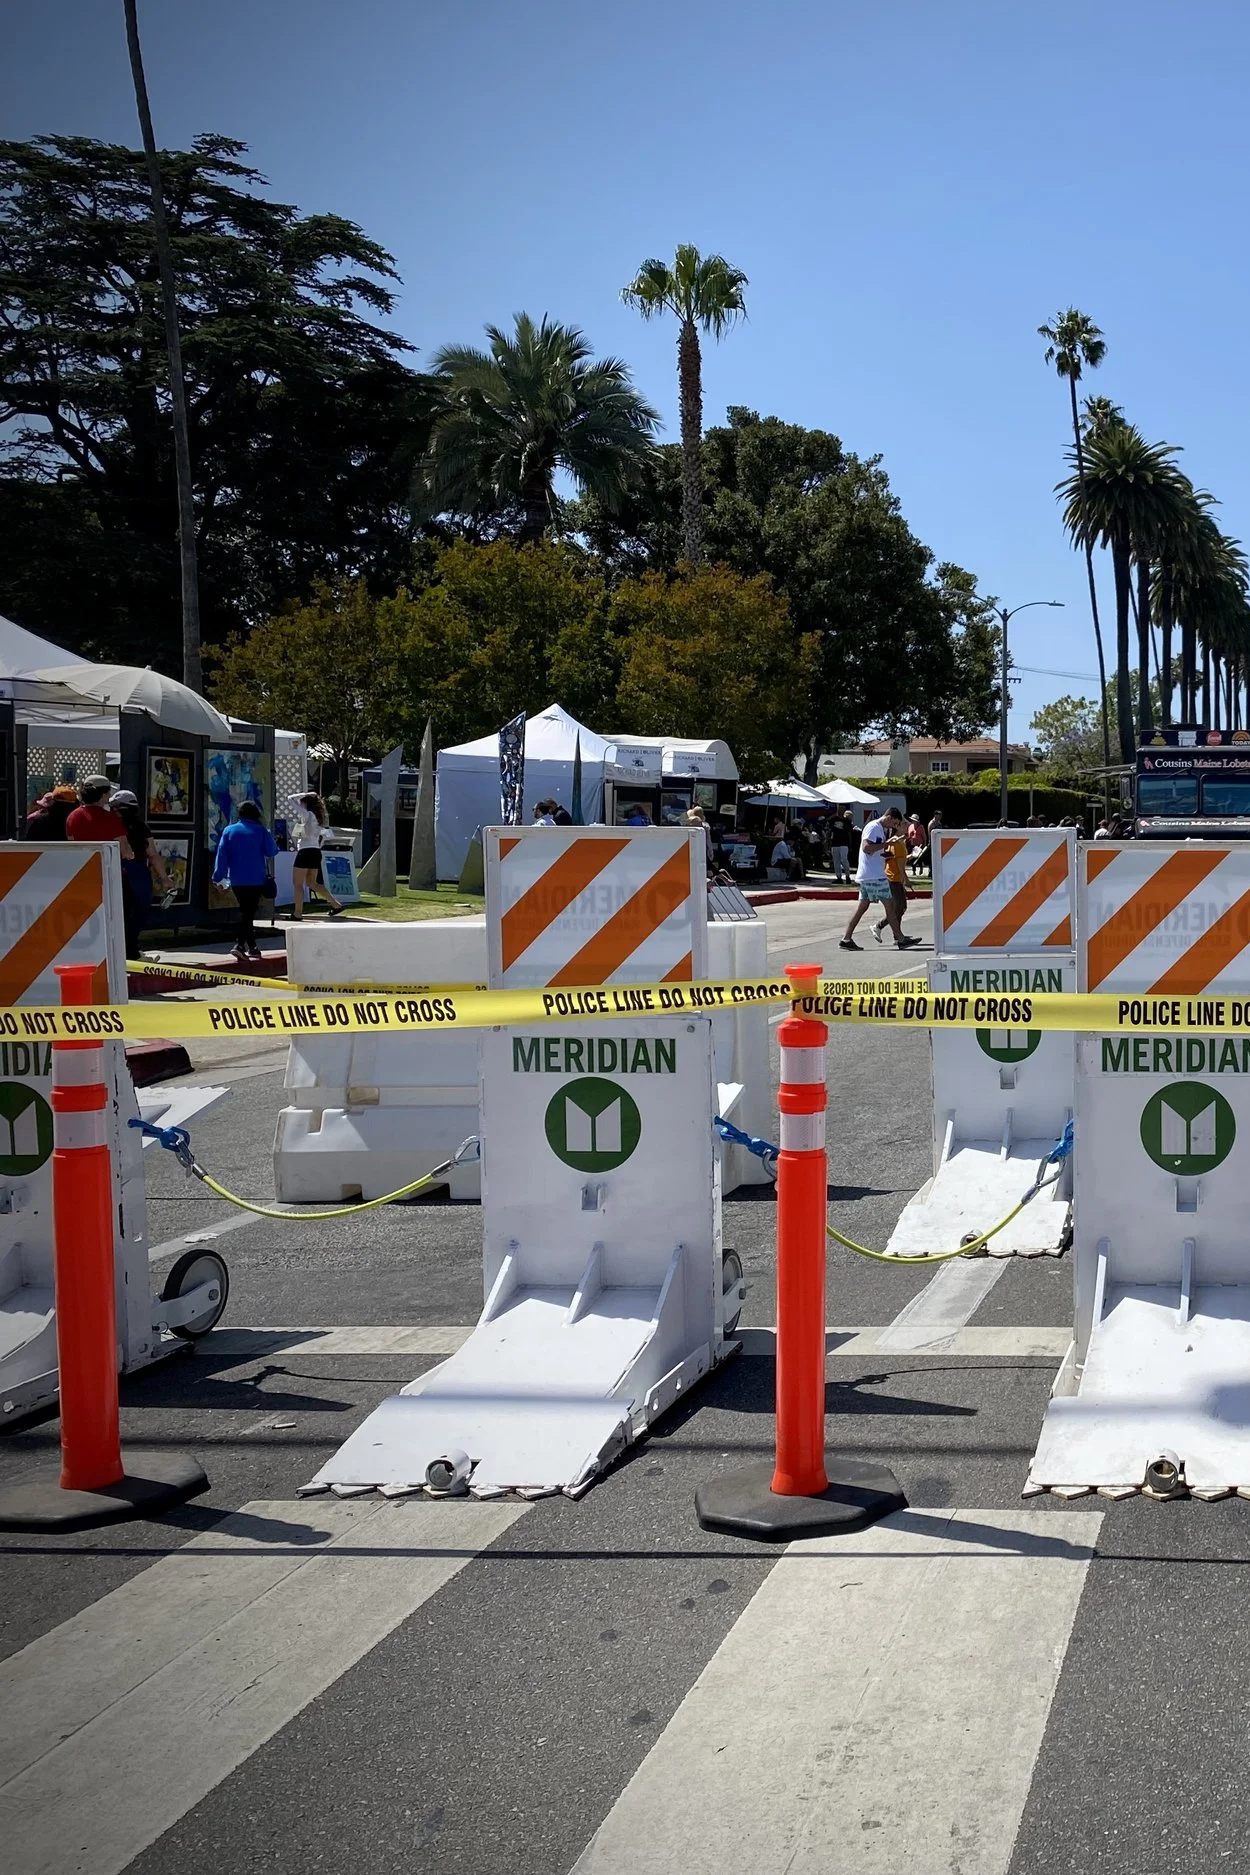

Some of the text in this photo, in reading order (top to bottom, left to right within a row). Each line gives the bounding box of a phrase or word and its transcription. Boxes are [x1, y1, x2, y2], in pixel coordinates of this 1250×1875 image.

[1155, 758, 1192, 768] Cousins
[1193, 758, 1222, 768] Maine
[951, 969, 1062, 993] MERIDIAN
[543, 984, 790, 1015] POLICE LINE DO NOT CROSS
[792, 998, 1032, 1022] POLICE LINE DO NOT CROSS
[21, 1013, 57, 1034] NOT
[62, 1011, 123, 1033] CROSS
[210, 999, 456, 1029] POLICE LINE DO NOT CROSS
[1119, 1001, 1180, 1025] POLICE
[1188, 1002, 1224, 1025] LINE
[513, 1036, 677, 1074] MERIDIAN
